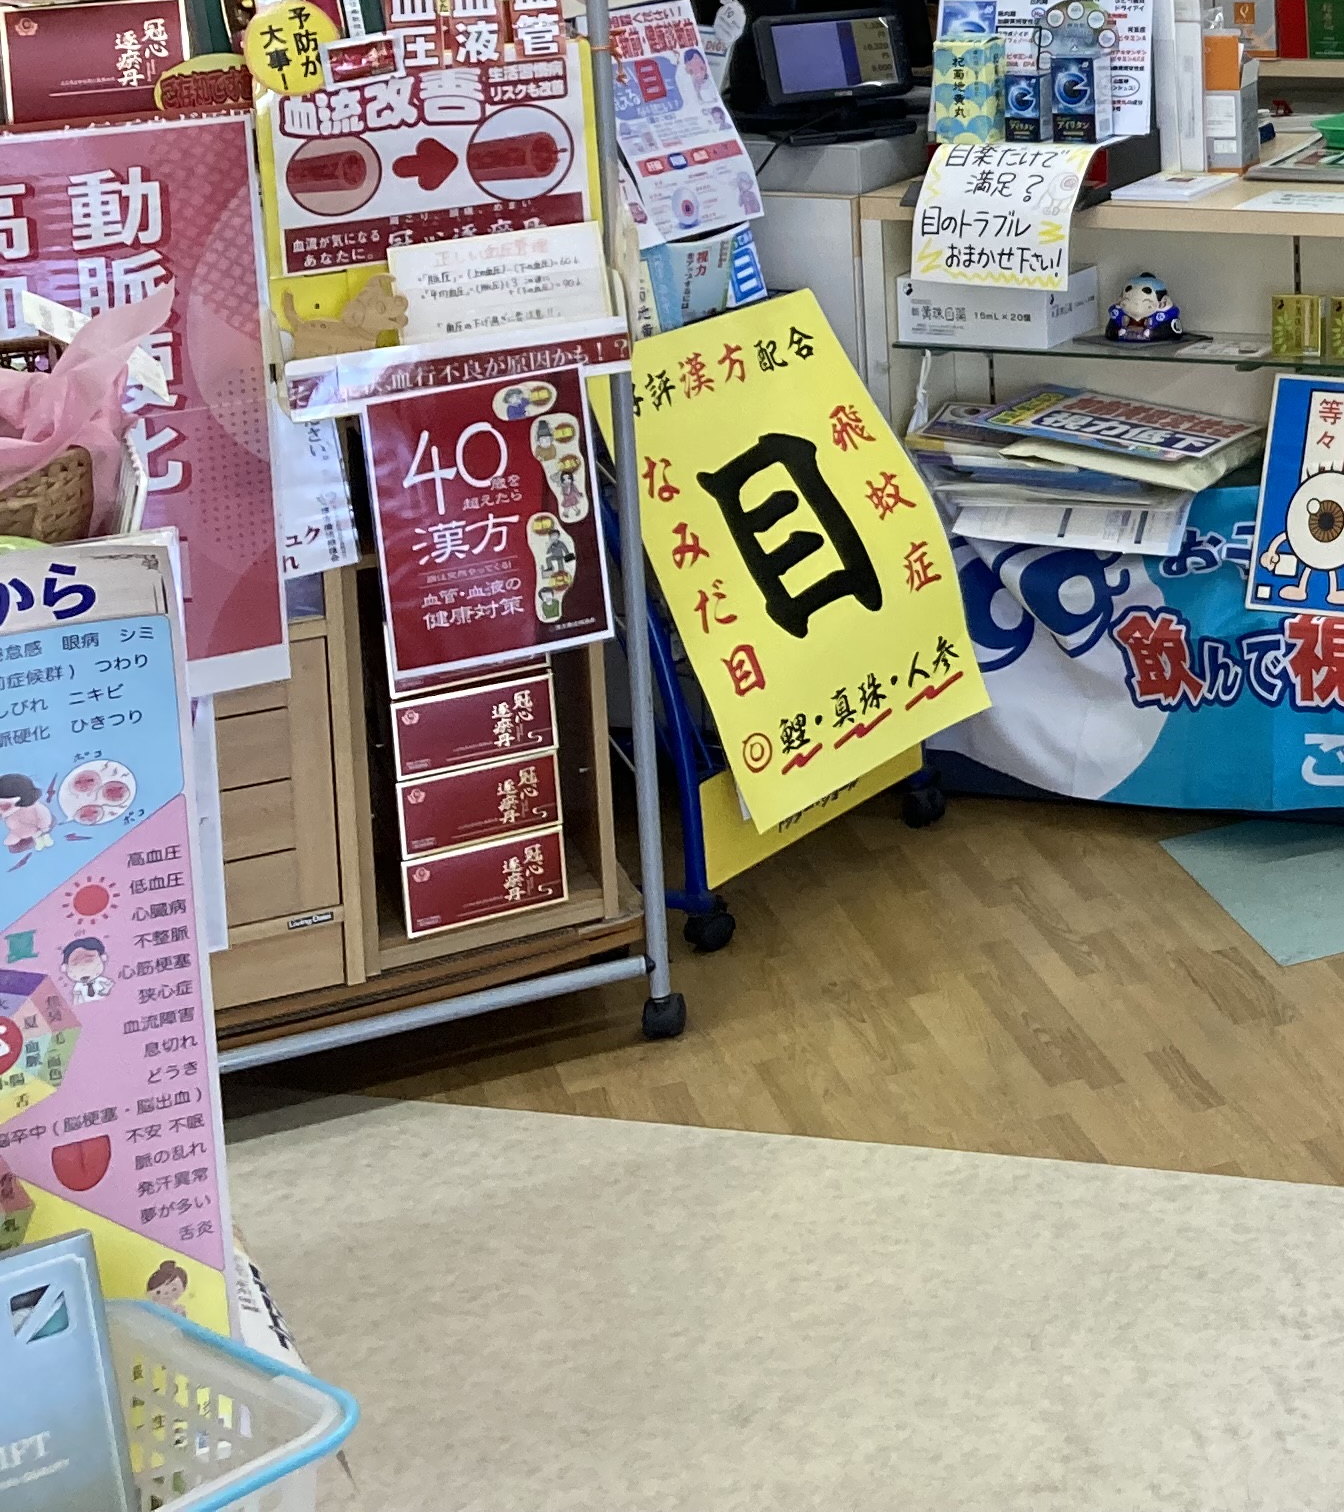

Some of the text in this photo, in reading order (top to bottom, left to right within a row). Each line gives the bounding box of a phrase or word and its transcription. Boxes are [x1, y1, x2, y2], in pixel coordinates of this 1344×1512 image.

[282, 68, 485, 136] 血流改善
[921, 206, 1031, 239] 目のトラブル
[292, 230, 380, 254] 血流が気になる
[304, 249, 375, 268] あなたに。
[945, 245, 1064, 278] おまかせ下さい!
[403, 422, 508, 515] 40
[829, 405, 942, 594] 飛蚊症
[412, 513, 520, 565] 漢方
[698, 433, 883, 639] 目
[642, 456, 767, 698] なみだ目
[423, 595, 524, 630] 健康対策
[63, 626, 155, 651] 眼病 シミ
[94, 653, 149, 675] つわり
[69, 682, 124, 706] ニキビ
[71, 709, 144, 734] ひきつり
[127, 845, 182, 868] 高血圧
[129, 873, 186, 896] 低血圧
[132, 899, 187, 922] 心臓病
[134, 926, 190, 949] 不整脈
[117, 952, 192, 981] 心筋梗塞
[137, 980, 194, 1004] 狭心症
[123, 1006, 195, 1036] 血流障害
[144, 1034, 199, 1058] 息切れ
[147, 1061, 199, 1085] どうき
[126, 1113, 205, 1144] 不安 不眠
[135, 1142, 207, 1170] 脈の乱れ
[137, 1168, 209, 1198] 発汗異常
[140, 1196, 212, 1224] 夢が多い
[179, 1220, 215, 1241] 舌炎
